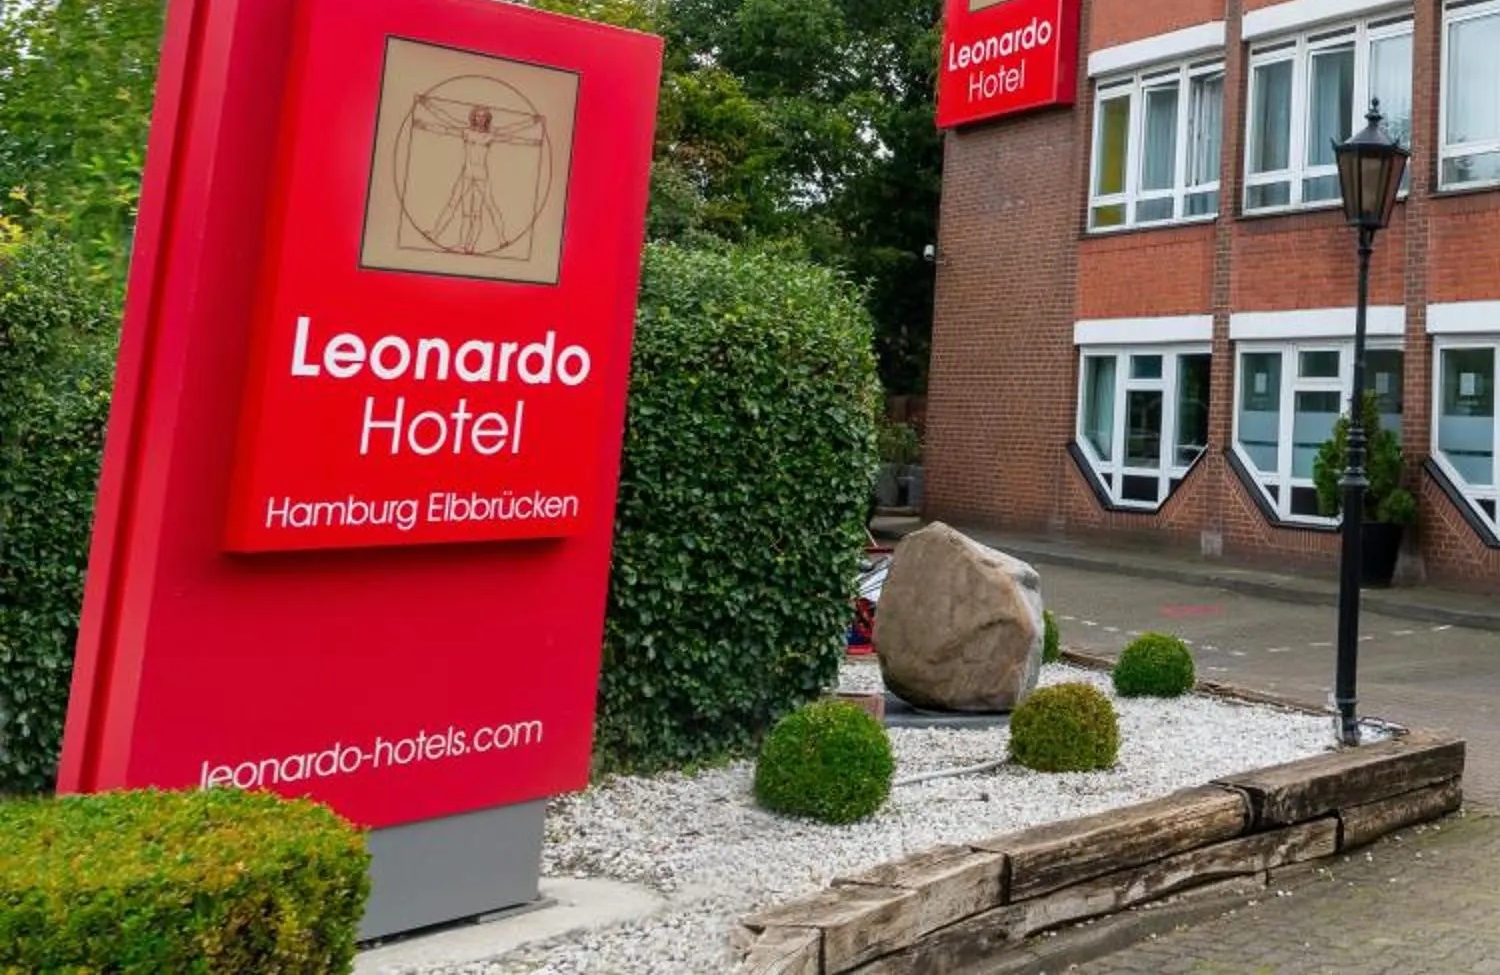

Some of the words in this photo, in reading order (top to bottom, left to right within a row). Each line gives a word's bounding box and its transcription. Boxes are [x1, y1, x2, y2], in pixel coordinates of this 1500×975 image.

[949, 17, 1052, 71] Leonardo
[968, 59, 1025, 102] Hotel
[291, 316, 592, 386] Leonardo
[359, 396, 525, 456] Hotel
[265, 496, 418, 530] Hamburg
[427, 490, 579, 522] Elbbrücken
[200, 719, 544, 793] leonardo-hotels.com
